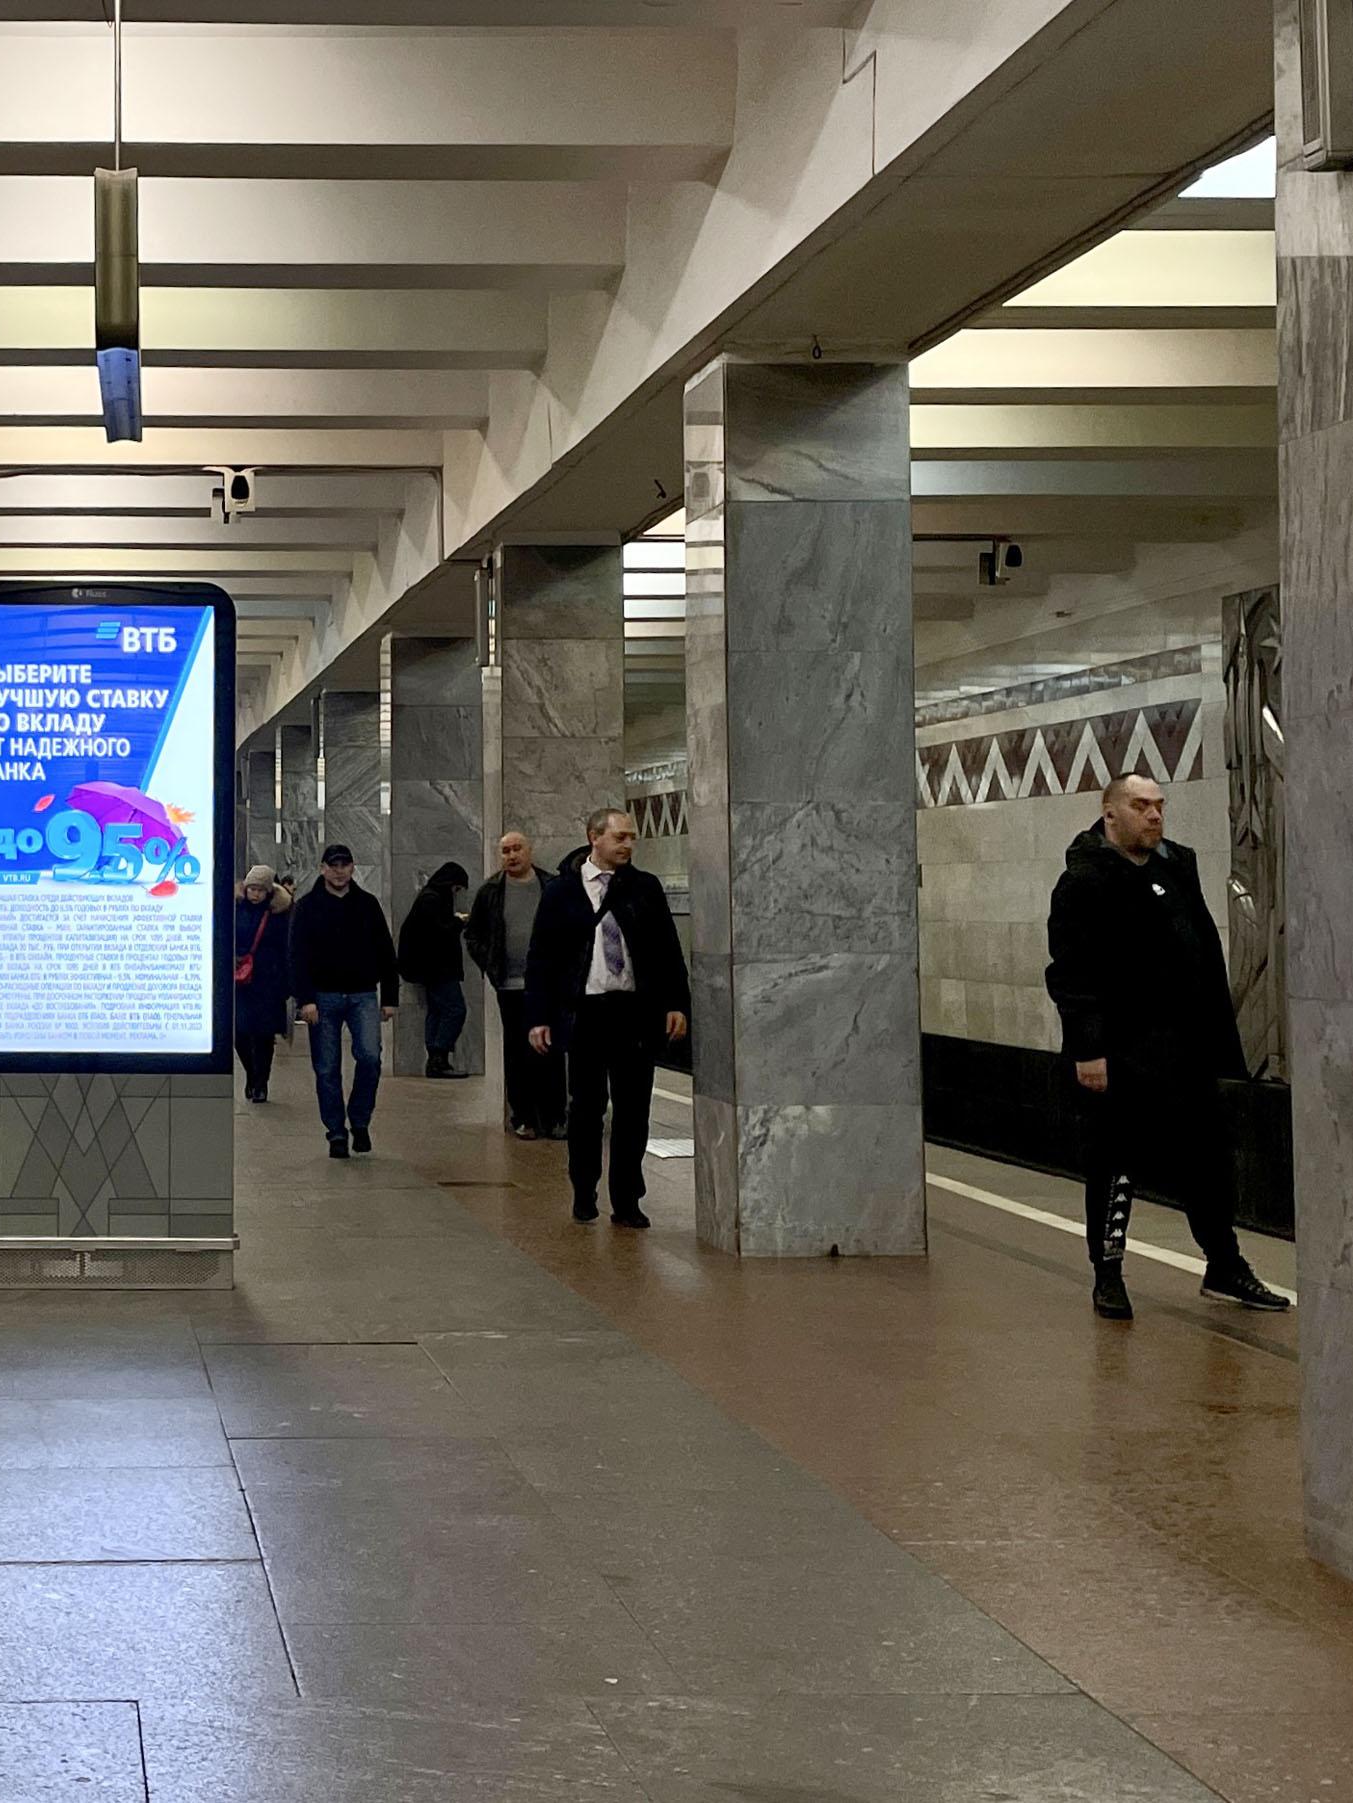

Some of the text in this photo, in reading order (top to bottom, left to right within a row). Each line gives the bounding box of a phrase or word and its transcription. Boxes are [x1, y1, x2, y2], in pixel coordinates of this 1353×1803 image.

[121, 626, 177, 653] ВТБ
[86, 688, 170, 709] СТАВКУ
[16, 712, 106, 737] ВКЛАДУ
[10, 735, 131, 760] НАДЕЖНОГО
